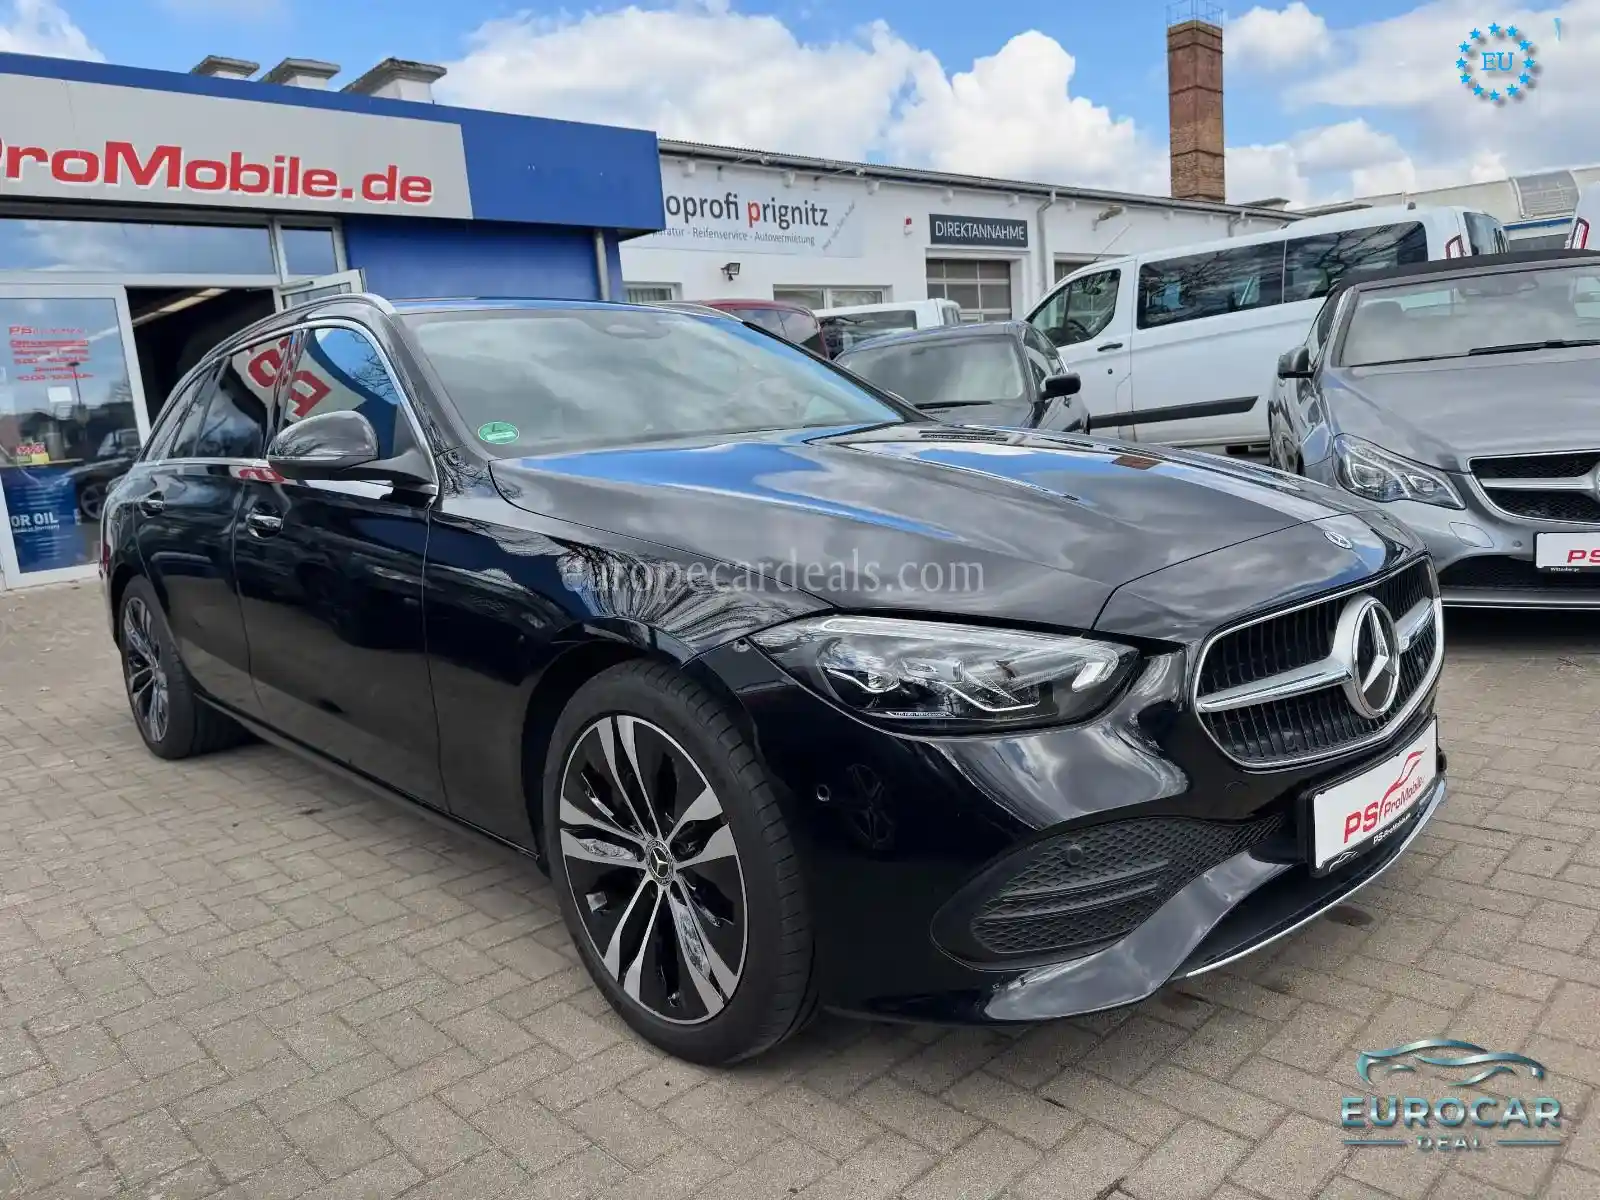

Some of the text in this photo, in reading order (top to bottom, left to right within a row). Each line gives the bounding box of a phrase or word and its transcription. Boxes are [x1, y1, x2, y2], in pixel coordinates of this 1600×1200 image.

[0, 137, 433, 204] roMobile.de
[747, 197, 828, 230] prignitz
[692, 227, 747, 240] Reifenservice
[754, 232, 815, 246] Autovermietung
[935, 221, 1025, 240] DIREKTANNAHME
[34, 511, 59, 526] OIL
[1343, 801, 1379, 844] PS
